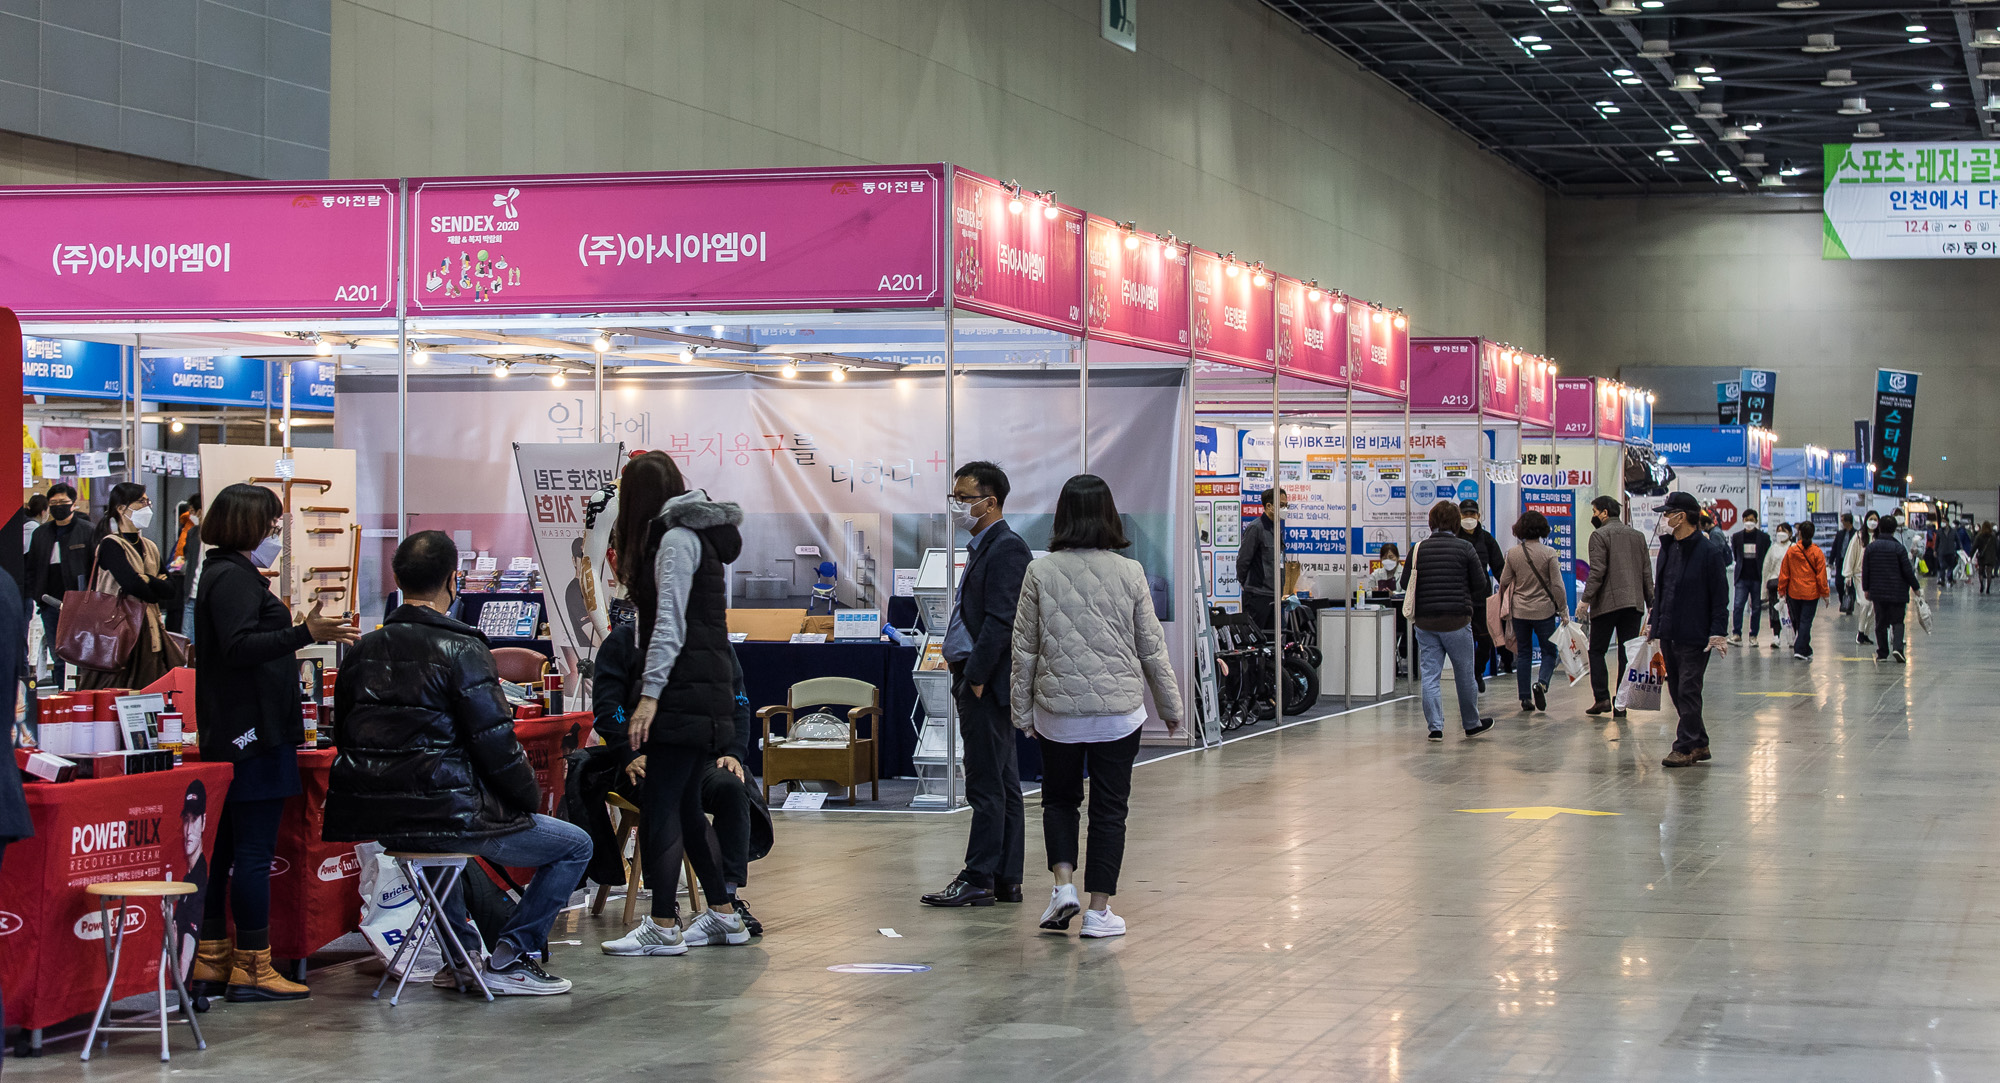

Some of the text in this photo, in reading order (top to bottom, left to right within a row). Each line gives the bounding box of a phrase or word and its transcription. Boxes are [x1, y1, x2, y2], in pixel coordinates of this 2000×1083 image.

[862, 181, 926, 195] 동아전람
[322, 195, 382, 208] 동아전람
[1889, 189, 2000, 210] 인천에서 다
[430, 215, 520, 233] SENDEX 2020
[1905, 220, 1929, 233] 12.4
[1964, 220, 1972, 233] 6
[468, 235, 482, 244] 복지
[52, 242, 231, 275] (주)아시아엠이
[578, 232, 767, 267] (주)아시아엠이
[997, 241, 1045, 284] (주)아시아엠이
[877, 273, 923, 291] A201
[334, 284, 378, 302] A201
[1121, 277, 1159, 312] (주)아시아엠이
[26, 338, 63, 360] 캠퍼필드
[1433, 345, 1469, 353] 동아전람
[22, 361, 73, 379] AMPER FIELD
[172, 373, 225, 390] CAMPER FIELD
[1441, 394, 1469, 405] A213
[548, 398, 651, 444] 일상에
[1565, 422, 1587, 432] A217
[670, 432, 820, 467] 복지용구를
[1369, 436, 1401, 449] 비과세
[828, 458, 921, 493] 더하다
[1696, 483, 1745, 494] Tera Force
[1717, 508, 1734, 522] TOP
[1289, 530, 1309, 541] 아무
[71, 817, 162, 855] POWERFULX
[69, 850, 161, 872] RECOVERY CREAM
